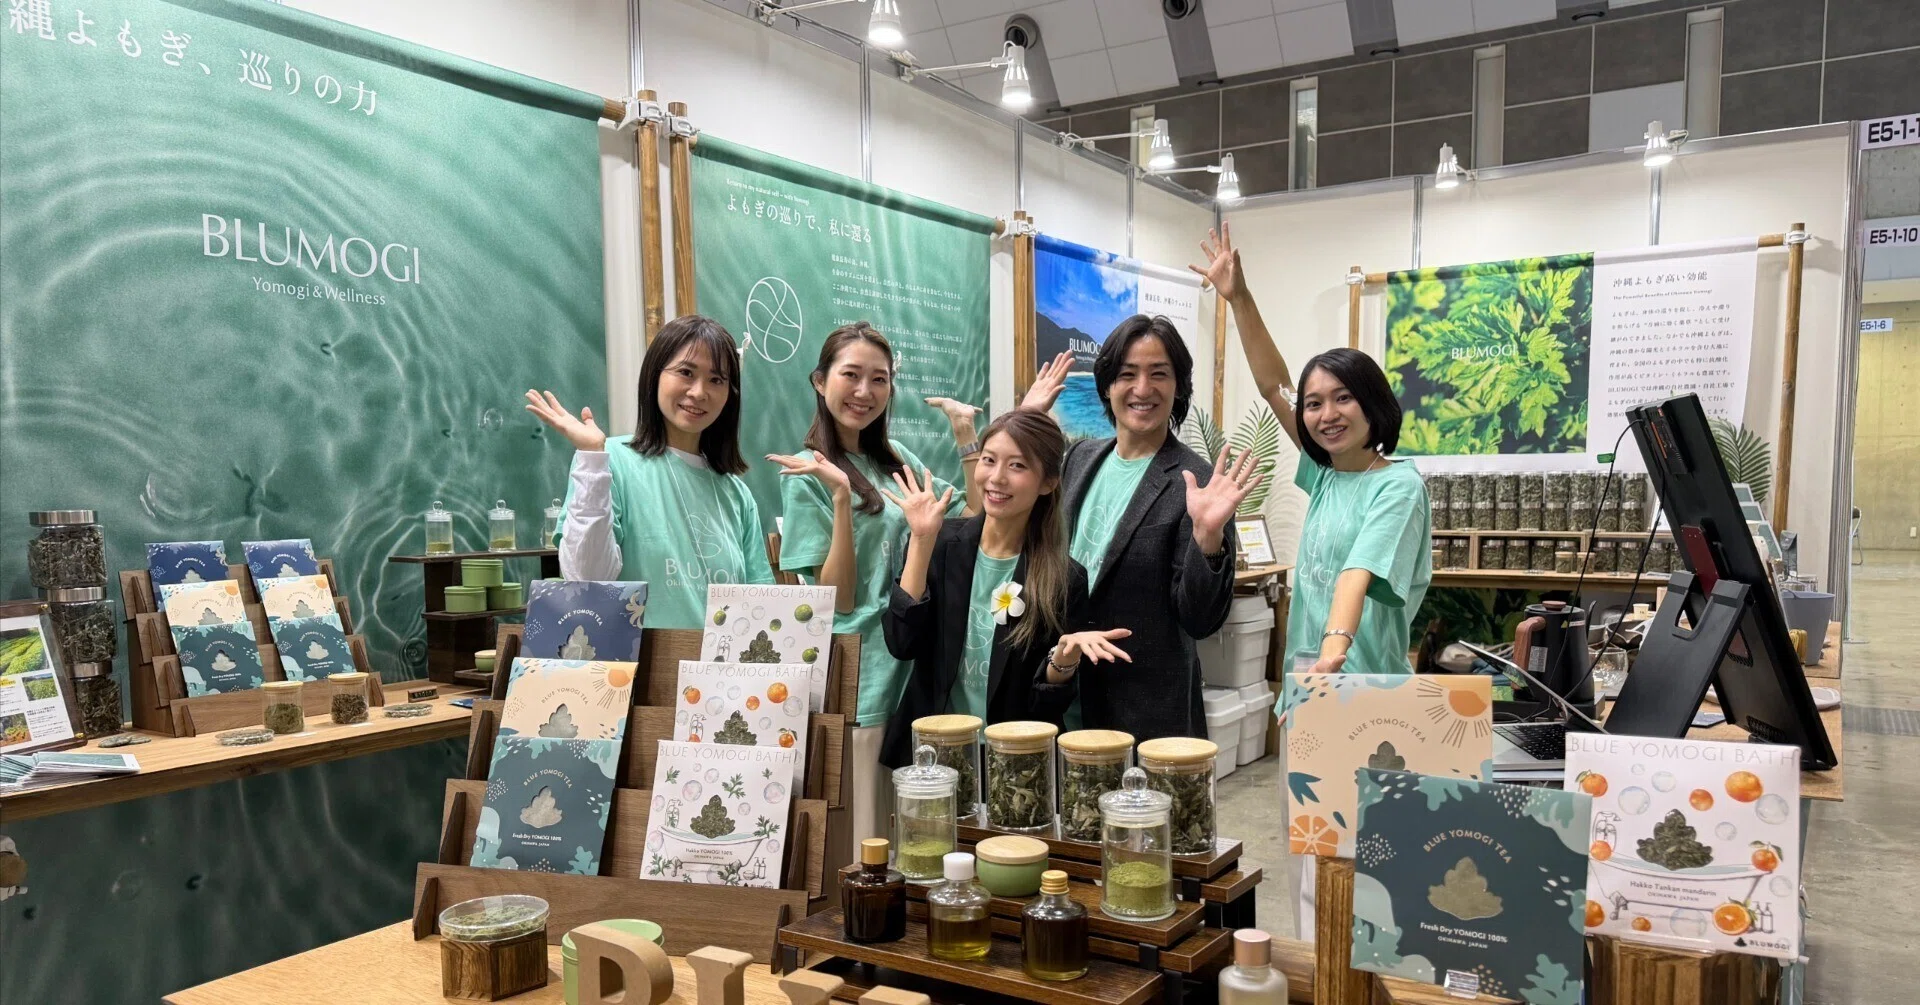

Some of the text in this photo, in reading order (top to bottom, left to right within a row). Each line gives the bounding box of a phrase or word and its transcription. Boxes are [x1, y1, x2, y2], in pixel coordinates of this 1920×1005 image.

[1869, 227, 1918, 244] E5-1-10
[202, 213, 420, 284] BLUMOGI
[1613, 271, 1708, 287] 沖縄よもぎ高い効能
[252, 276, 386, 305] Yomogi & Wellness
[1860, 320, 1886, 331] E5-1-6
[1069, 337, 1102, 355] BLUMOG
[1451, 344, 1516, 360] BLUMOGI
[711, 586, 736, 598] BLUE
[741, 586, 794, 598] YOMOGI
[798, 588, 833, 600] BATH
[557, 612, 571, 625] BLUE
[594, 614, 603, 626] TEA
[681, 663, 808, 678] BLUE YOMOGI BATH
[1348, 718, 1427, 743] BLUE YOMOGI TEA
[660, 745, 792, 763] BLUE YOMOGI BATH
[1571, 737, 1795, 767] BLUE YOMOGI BATH
[523, 769, 573, 788] BLUE YOMOGI TEA
[1423, 829, 1512, 864] BLUE YOMOGI TEA
[1630, 881, 1717, 896] Hakko Tankan mandarin
[1420, 922, 1508, 943] Fresh Dry YOMOGI 100%
[1438, 935, 1488, 949] OKINAWA JAPAN
[1749, 940, 1790, 950] BLUMOGI
